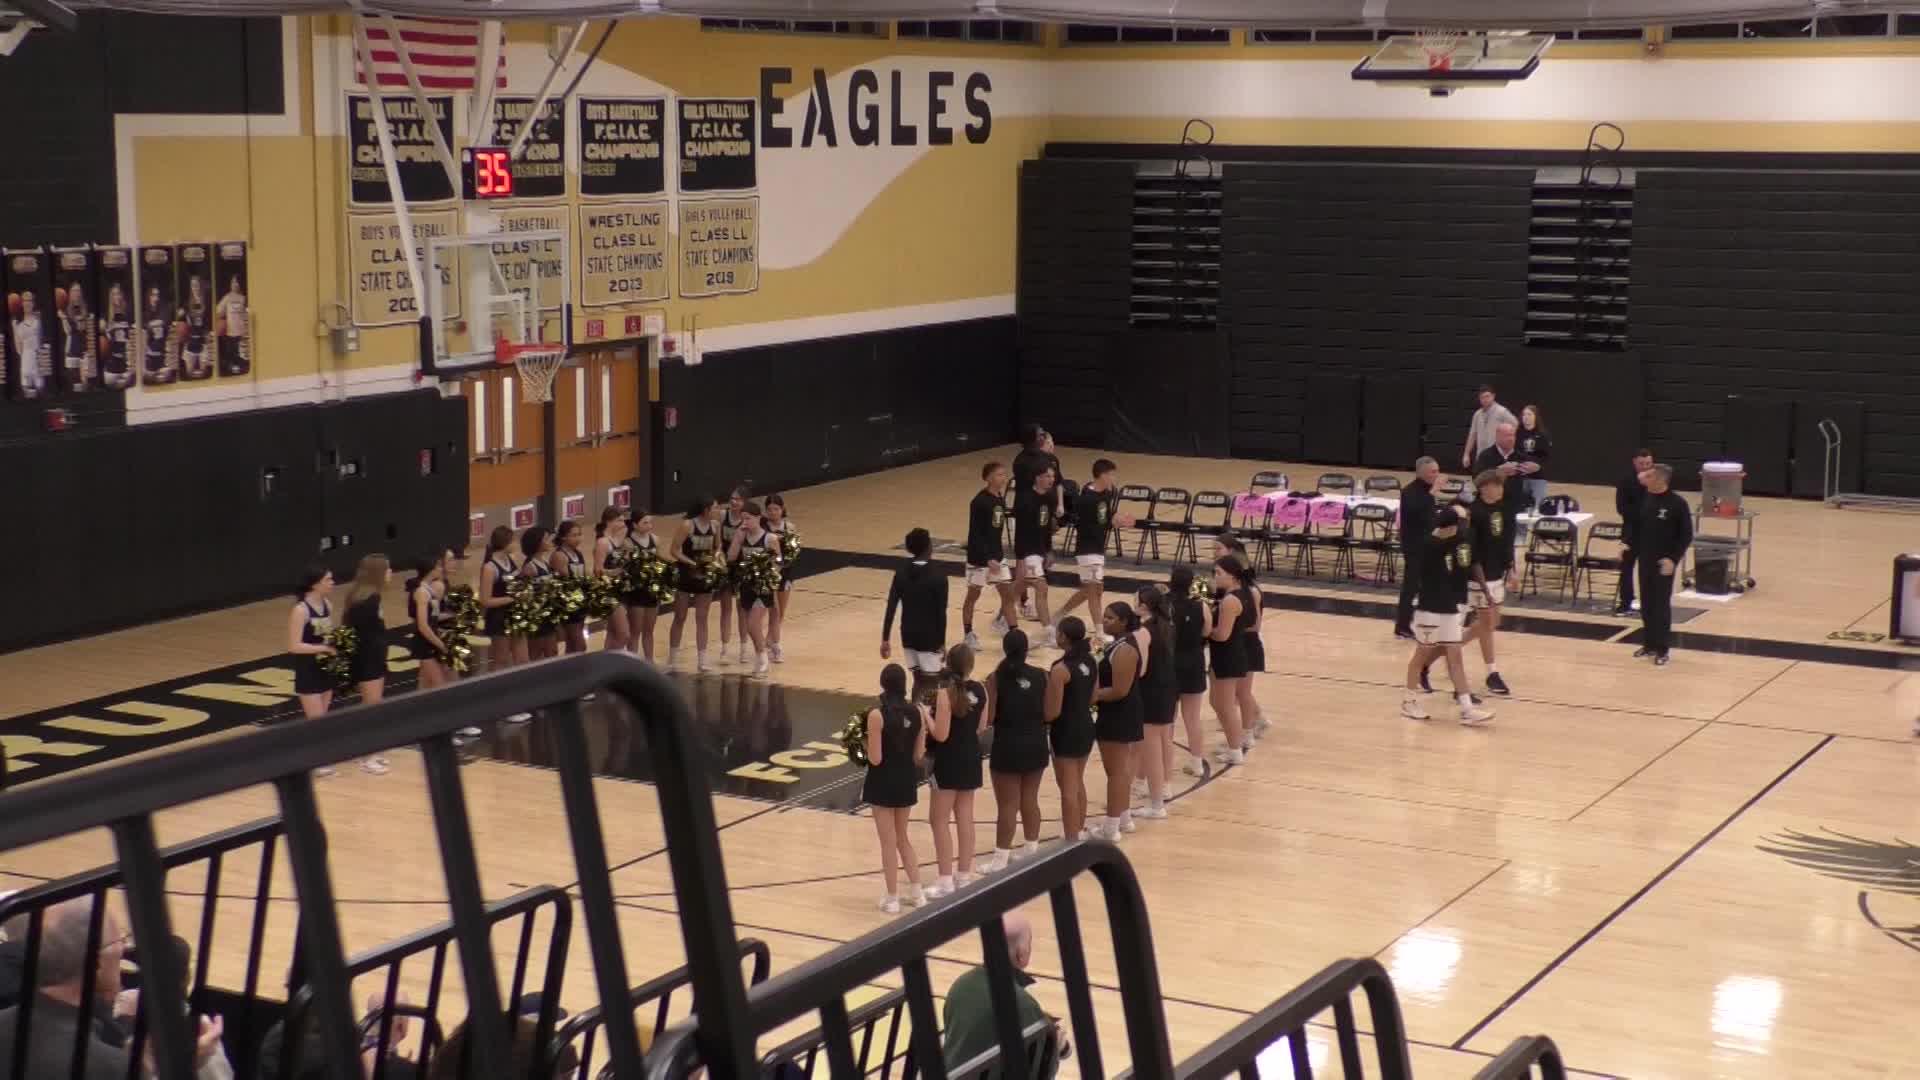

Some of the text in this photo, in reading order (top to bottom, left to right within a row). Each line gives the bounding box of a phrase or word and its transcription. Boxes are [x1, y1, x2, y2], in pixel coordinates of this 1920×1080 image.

[760, 67, 992, 148] EAGLES
[475, 152, 512, 194] 35
[589, 213, 661, 229] WRESTLING
[593, 234, 656, 250] CLASS LL
[690, 227, 748, 243] CLASS LL
[587, 251, 664, 275] STATE CHAMPIONS
[685, 249, 709, 267] STATE
[361, 271, 393, 292] STATE
